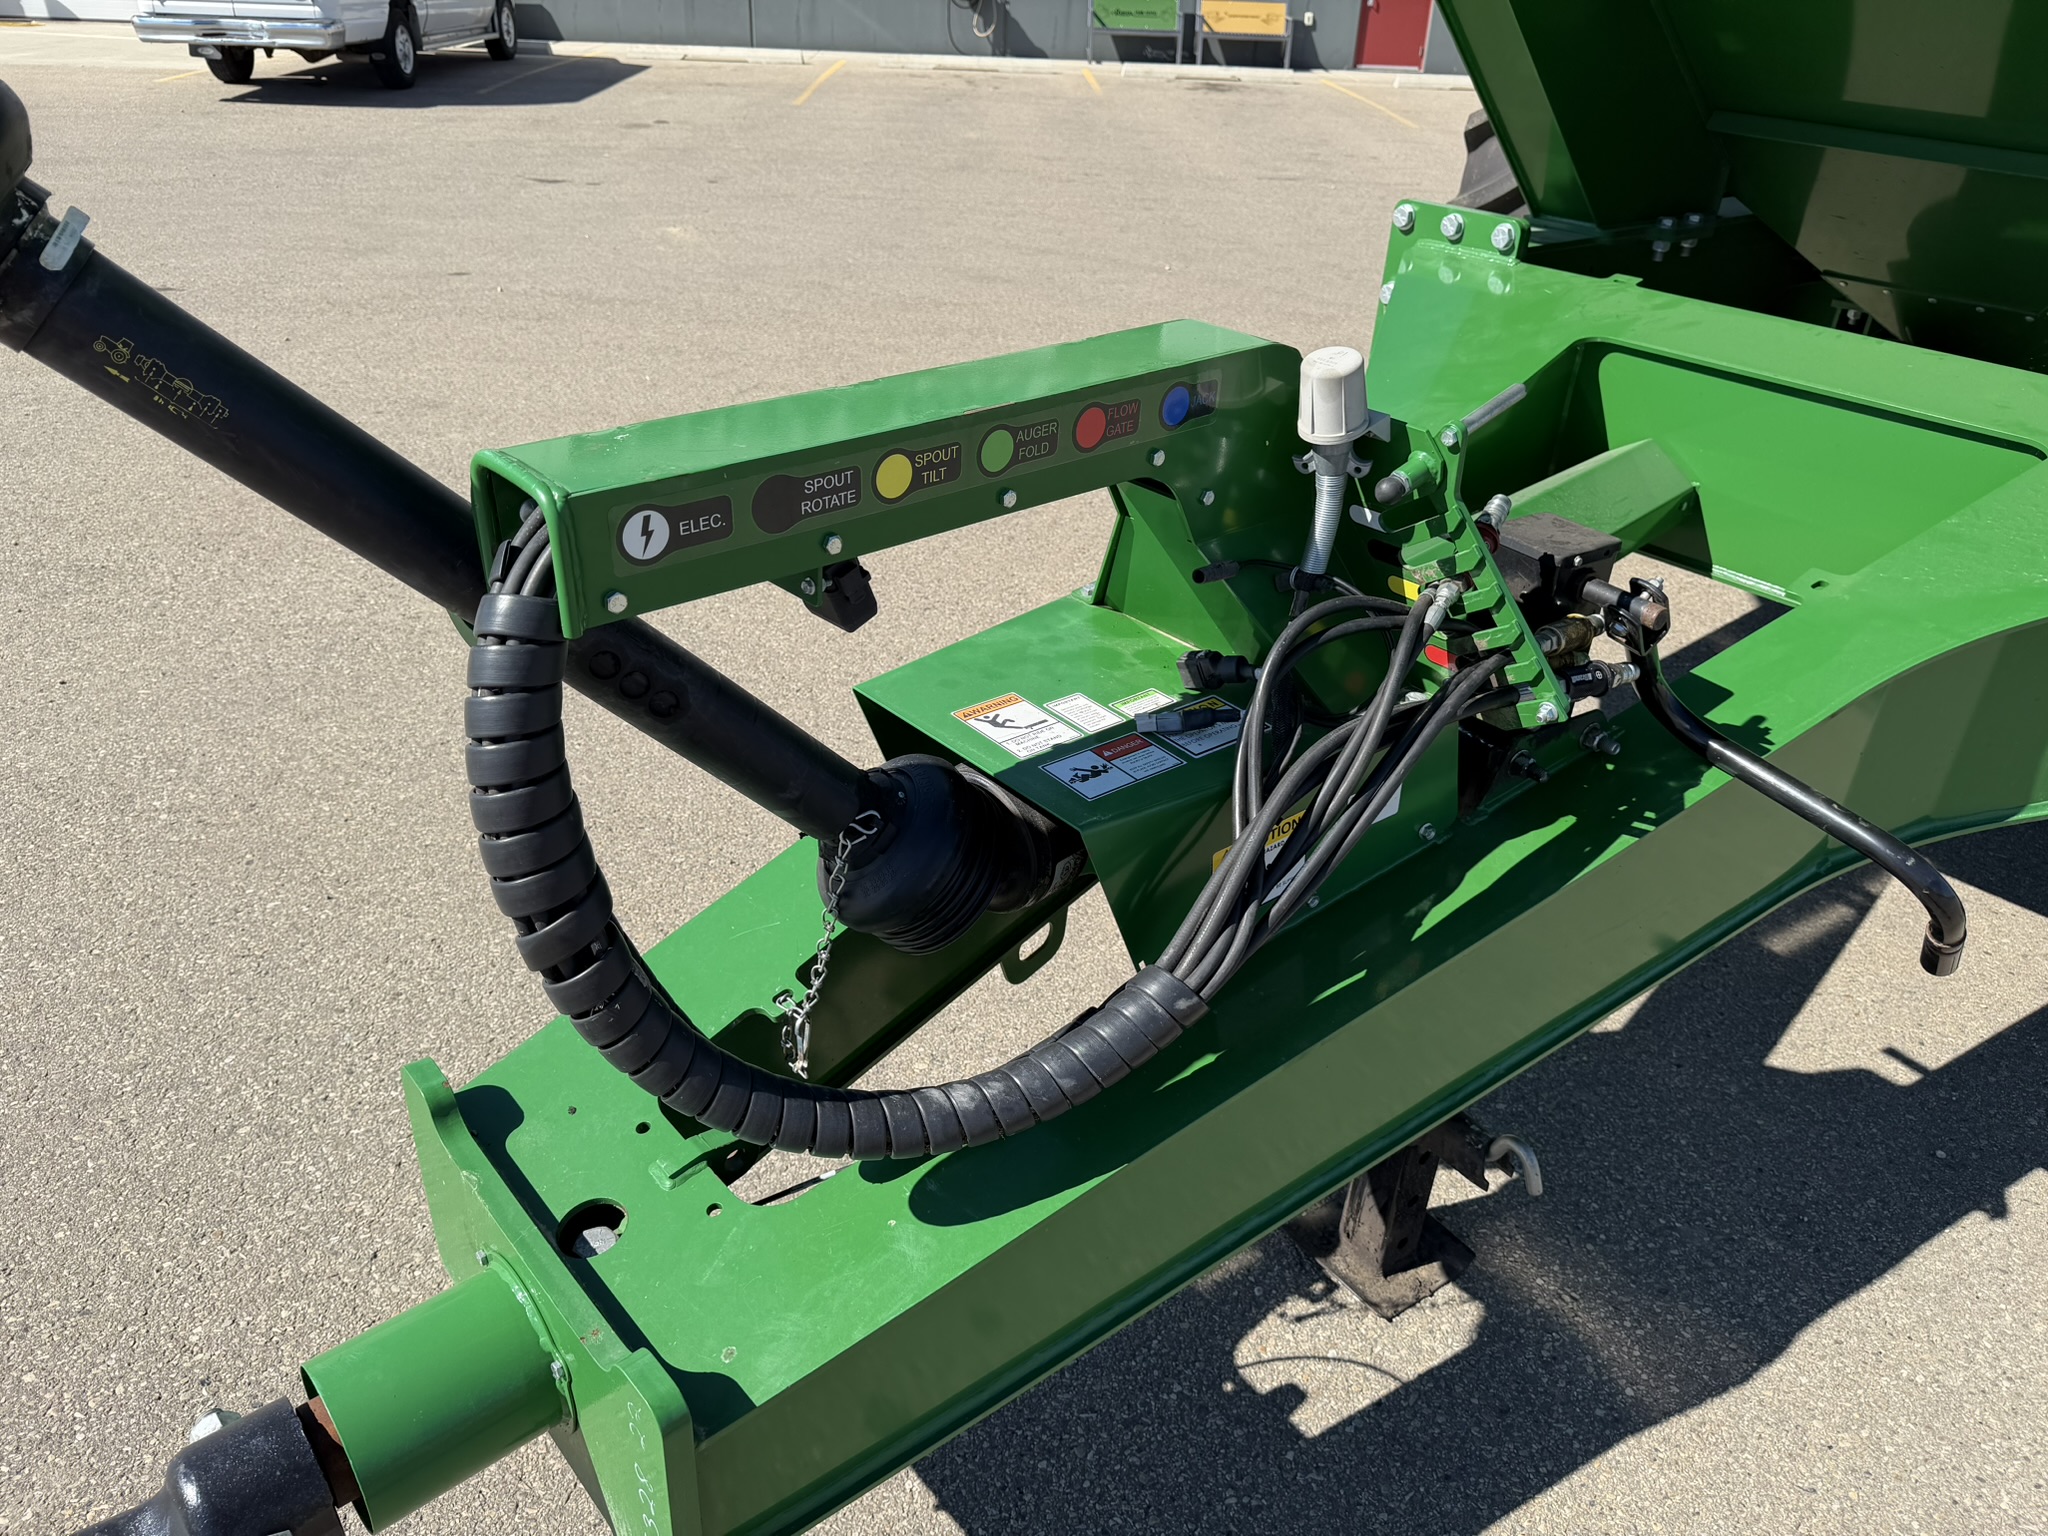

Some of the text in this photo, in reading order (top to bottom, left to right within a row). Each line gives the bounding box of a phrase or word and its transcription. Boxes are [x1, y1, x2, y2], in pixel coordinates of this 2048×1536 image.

[1190, 391, 1216, 408] JACK
[1107, 402, 1139, 420] FLOW
[1016, 422, 1058, 443] AUGER
[1106, 420, 1134, 437] GATE
[914, 445, 960, 468] SPOUT
[1018, 442, 1049, 460] FOLD
[804, 470, 854, 494] SPOUT
[921, 467, 947, 485] TILT
[801, 489, 857, 515] ROTATE
[679, 513, 726, 536] ELEC.
[969, 695, 1019, 716] WARNING
[1111, 739, 1144, 754] DANGER
